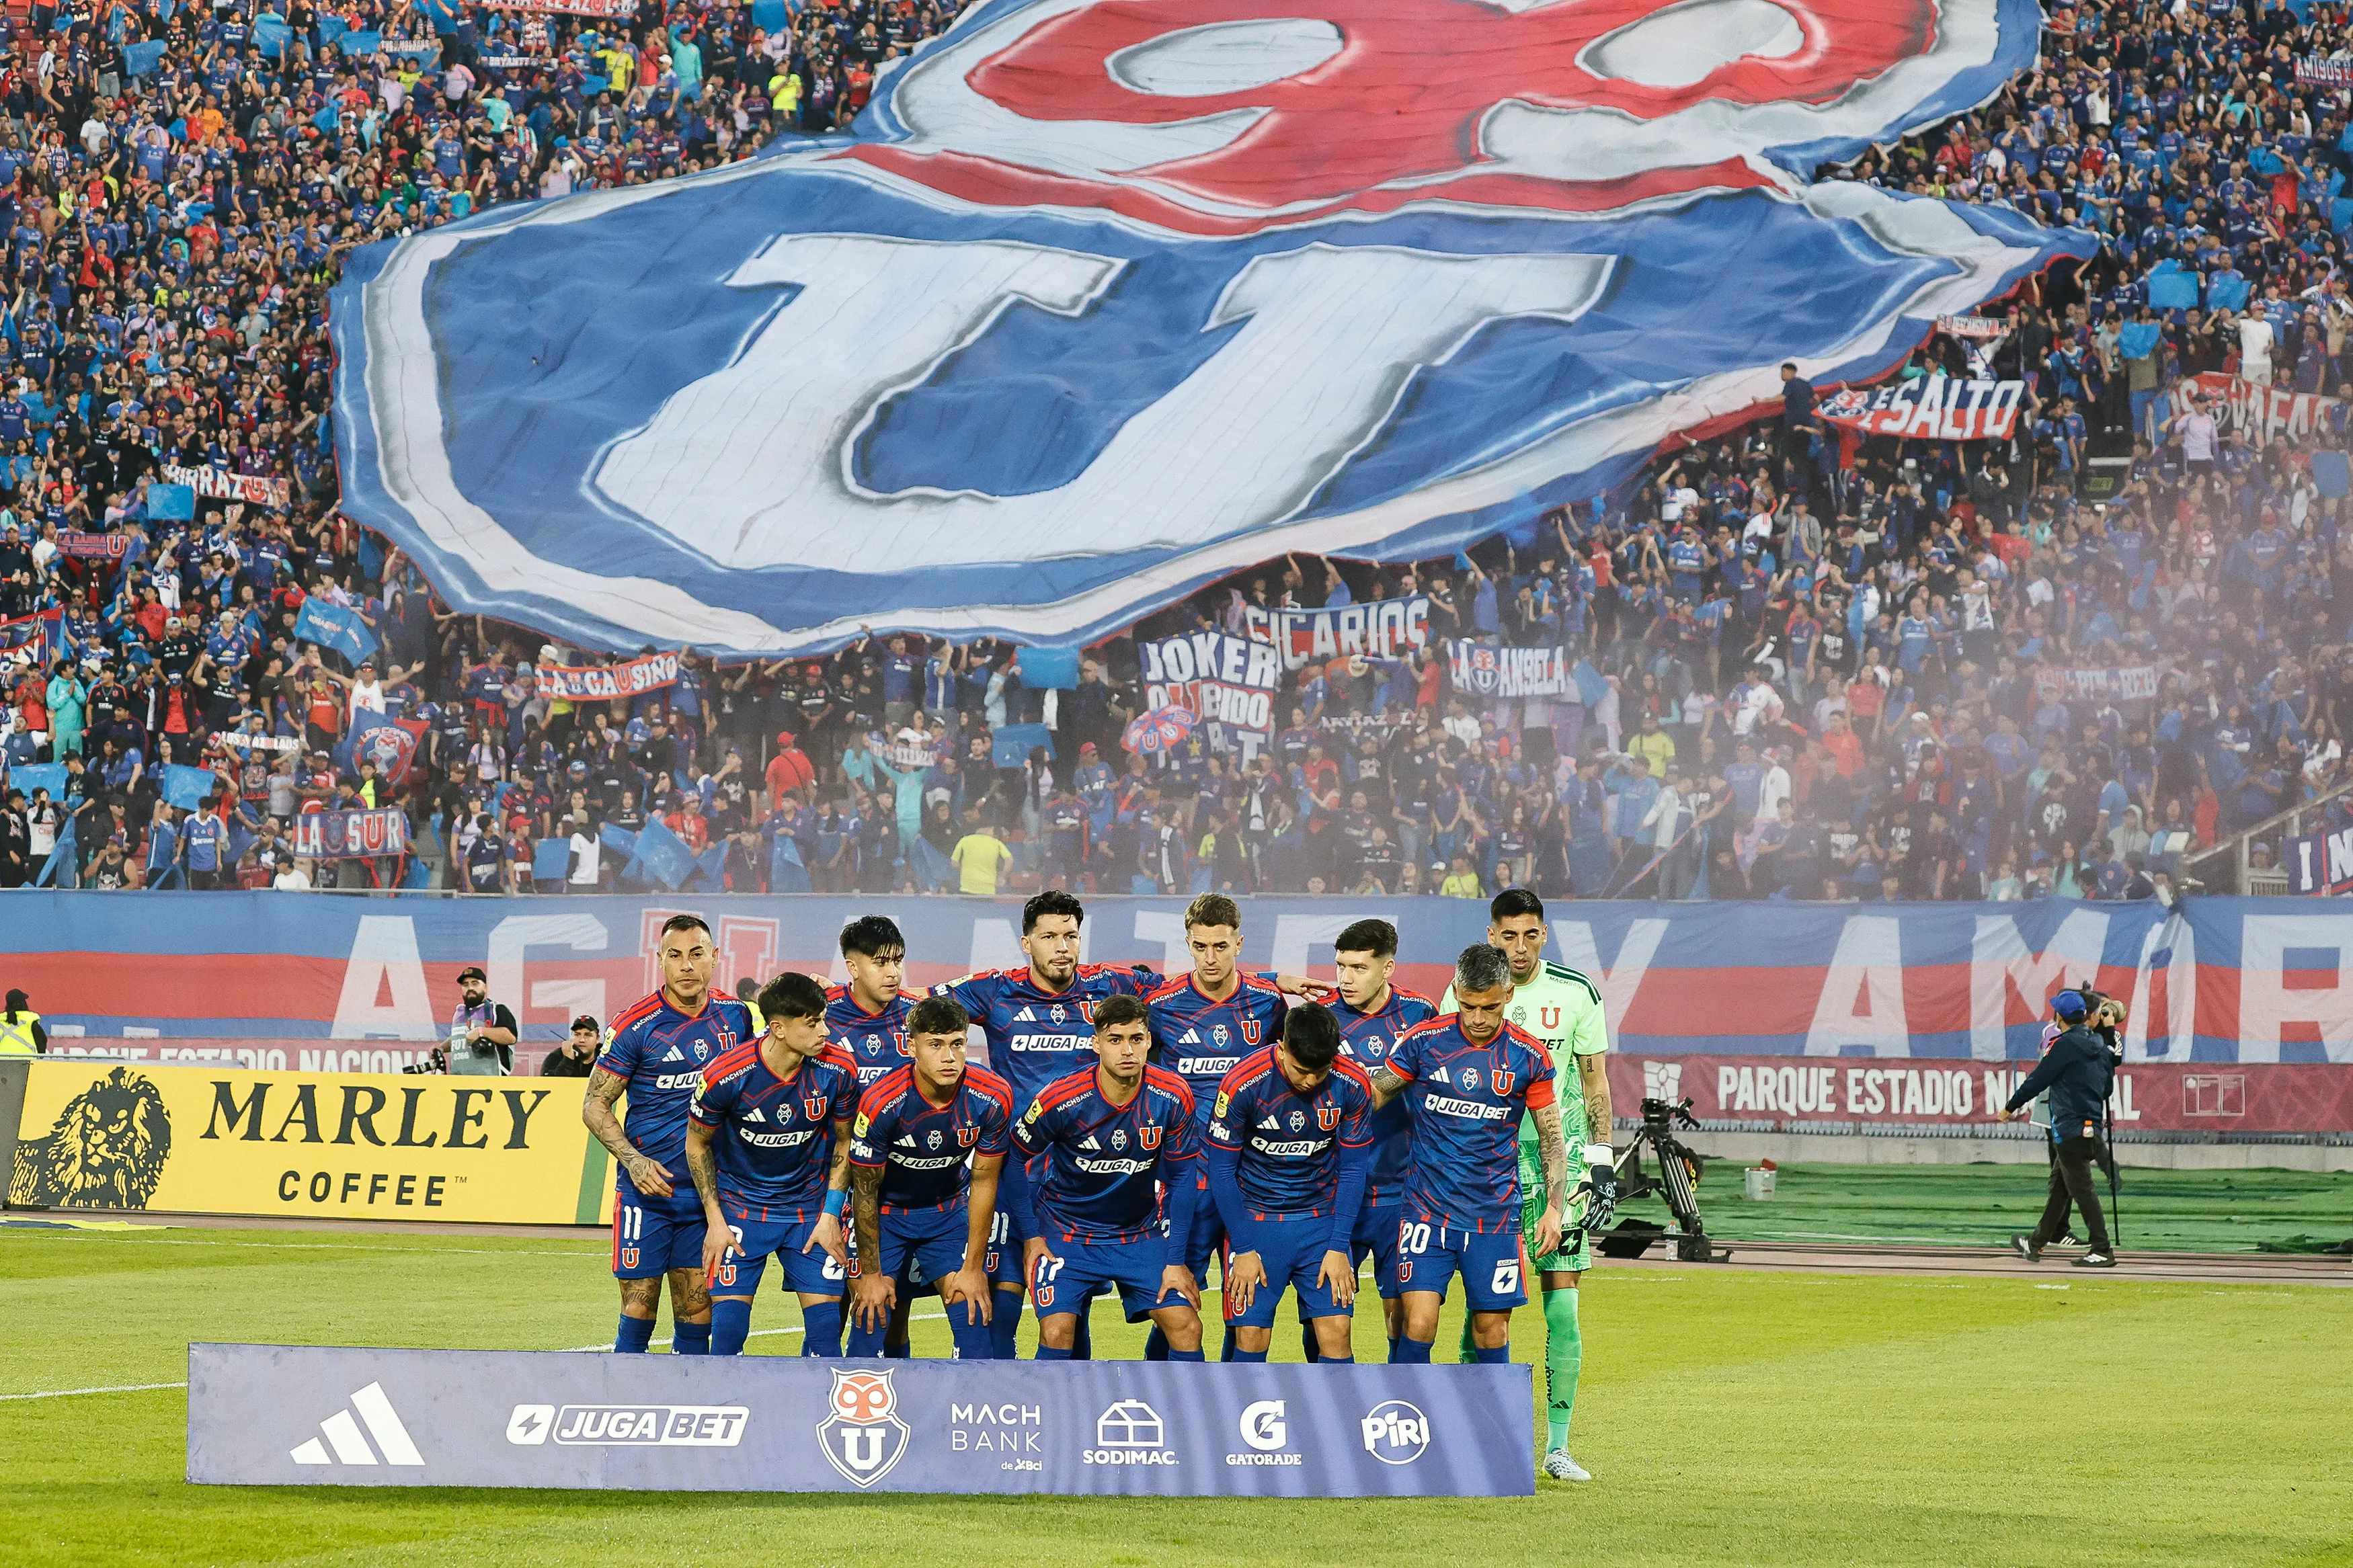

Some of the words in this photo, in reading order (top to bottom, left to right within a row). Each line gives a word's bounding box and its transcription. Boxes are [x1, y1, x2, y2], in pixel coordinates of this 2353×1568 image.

[1880, 374, 2025, 438] SALTO
[1145, 632, 1276, 688] JOKER
[296, 816, 323, 854] LA
[348, 811, 401, 852] SUR
[1150, 987, 1188, 1006] MACHBANK
[1804, 907, 2353, 1064] AMOR
[1399, 995, 1434, 1009] MACHBANK
[1540, 1007, 1561, 1030] U
[1241, 1020, 1261, 1046] U
[1412, 1026, 1451, 1041] MACHBANK
[1509, 1035, 1543, 1060] MACHBANK
[719, 1062, 757, 1087] MACHBANK
[1238, 1069, 1272, 1094] MACHBANK
[1491, 1069, 1516, 1096] U
[1056, 1090, 1094, 1114] MACHBANK
[1718, 1065, 1838, 1114] PARQUE
[1847, 1068, 1974, 1116] ESTADIO
[200, 1081, 551, 1151] MARLEY
[803, 1096, 828, 1122] U
[1316, 1107, 1341, 1131] U
[957, 1126, 982, 1148] U
[1139, 1125, 1163, 1151] U
[278, 1170, 446, 1207] COFFEE
[624, 1206, 643, 1241] 11
[1399, 1222, 1431, 1254] 20
[622, 1247, 640, 1269] U
[719, 1264, 737, 1286] U
[1399, 1261, 1413, 1282] U
[1037, 1285, 1055, 1307] U
[951, 1403, 1041, 1426] MACH
[841, 1428, 886, 1471] U
[951, 1430, 1041, 1452] BANK
[1001, 1460, 1013, 1470] de
[1026, 1460, 1043, 1471] Bci
[1082, 1449, 1176, 1465] SODIMAC
[1225, 1454, 1302, 1466] GATORADE
